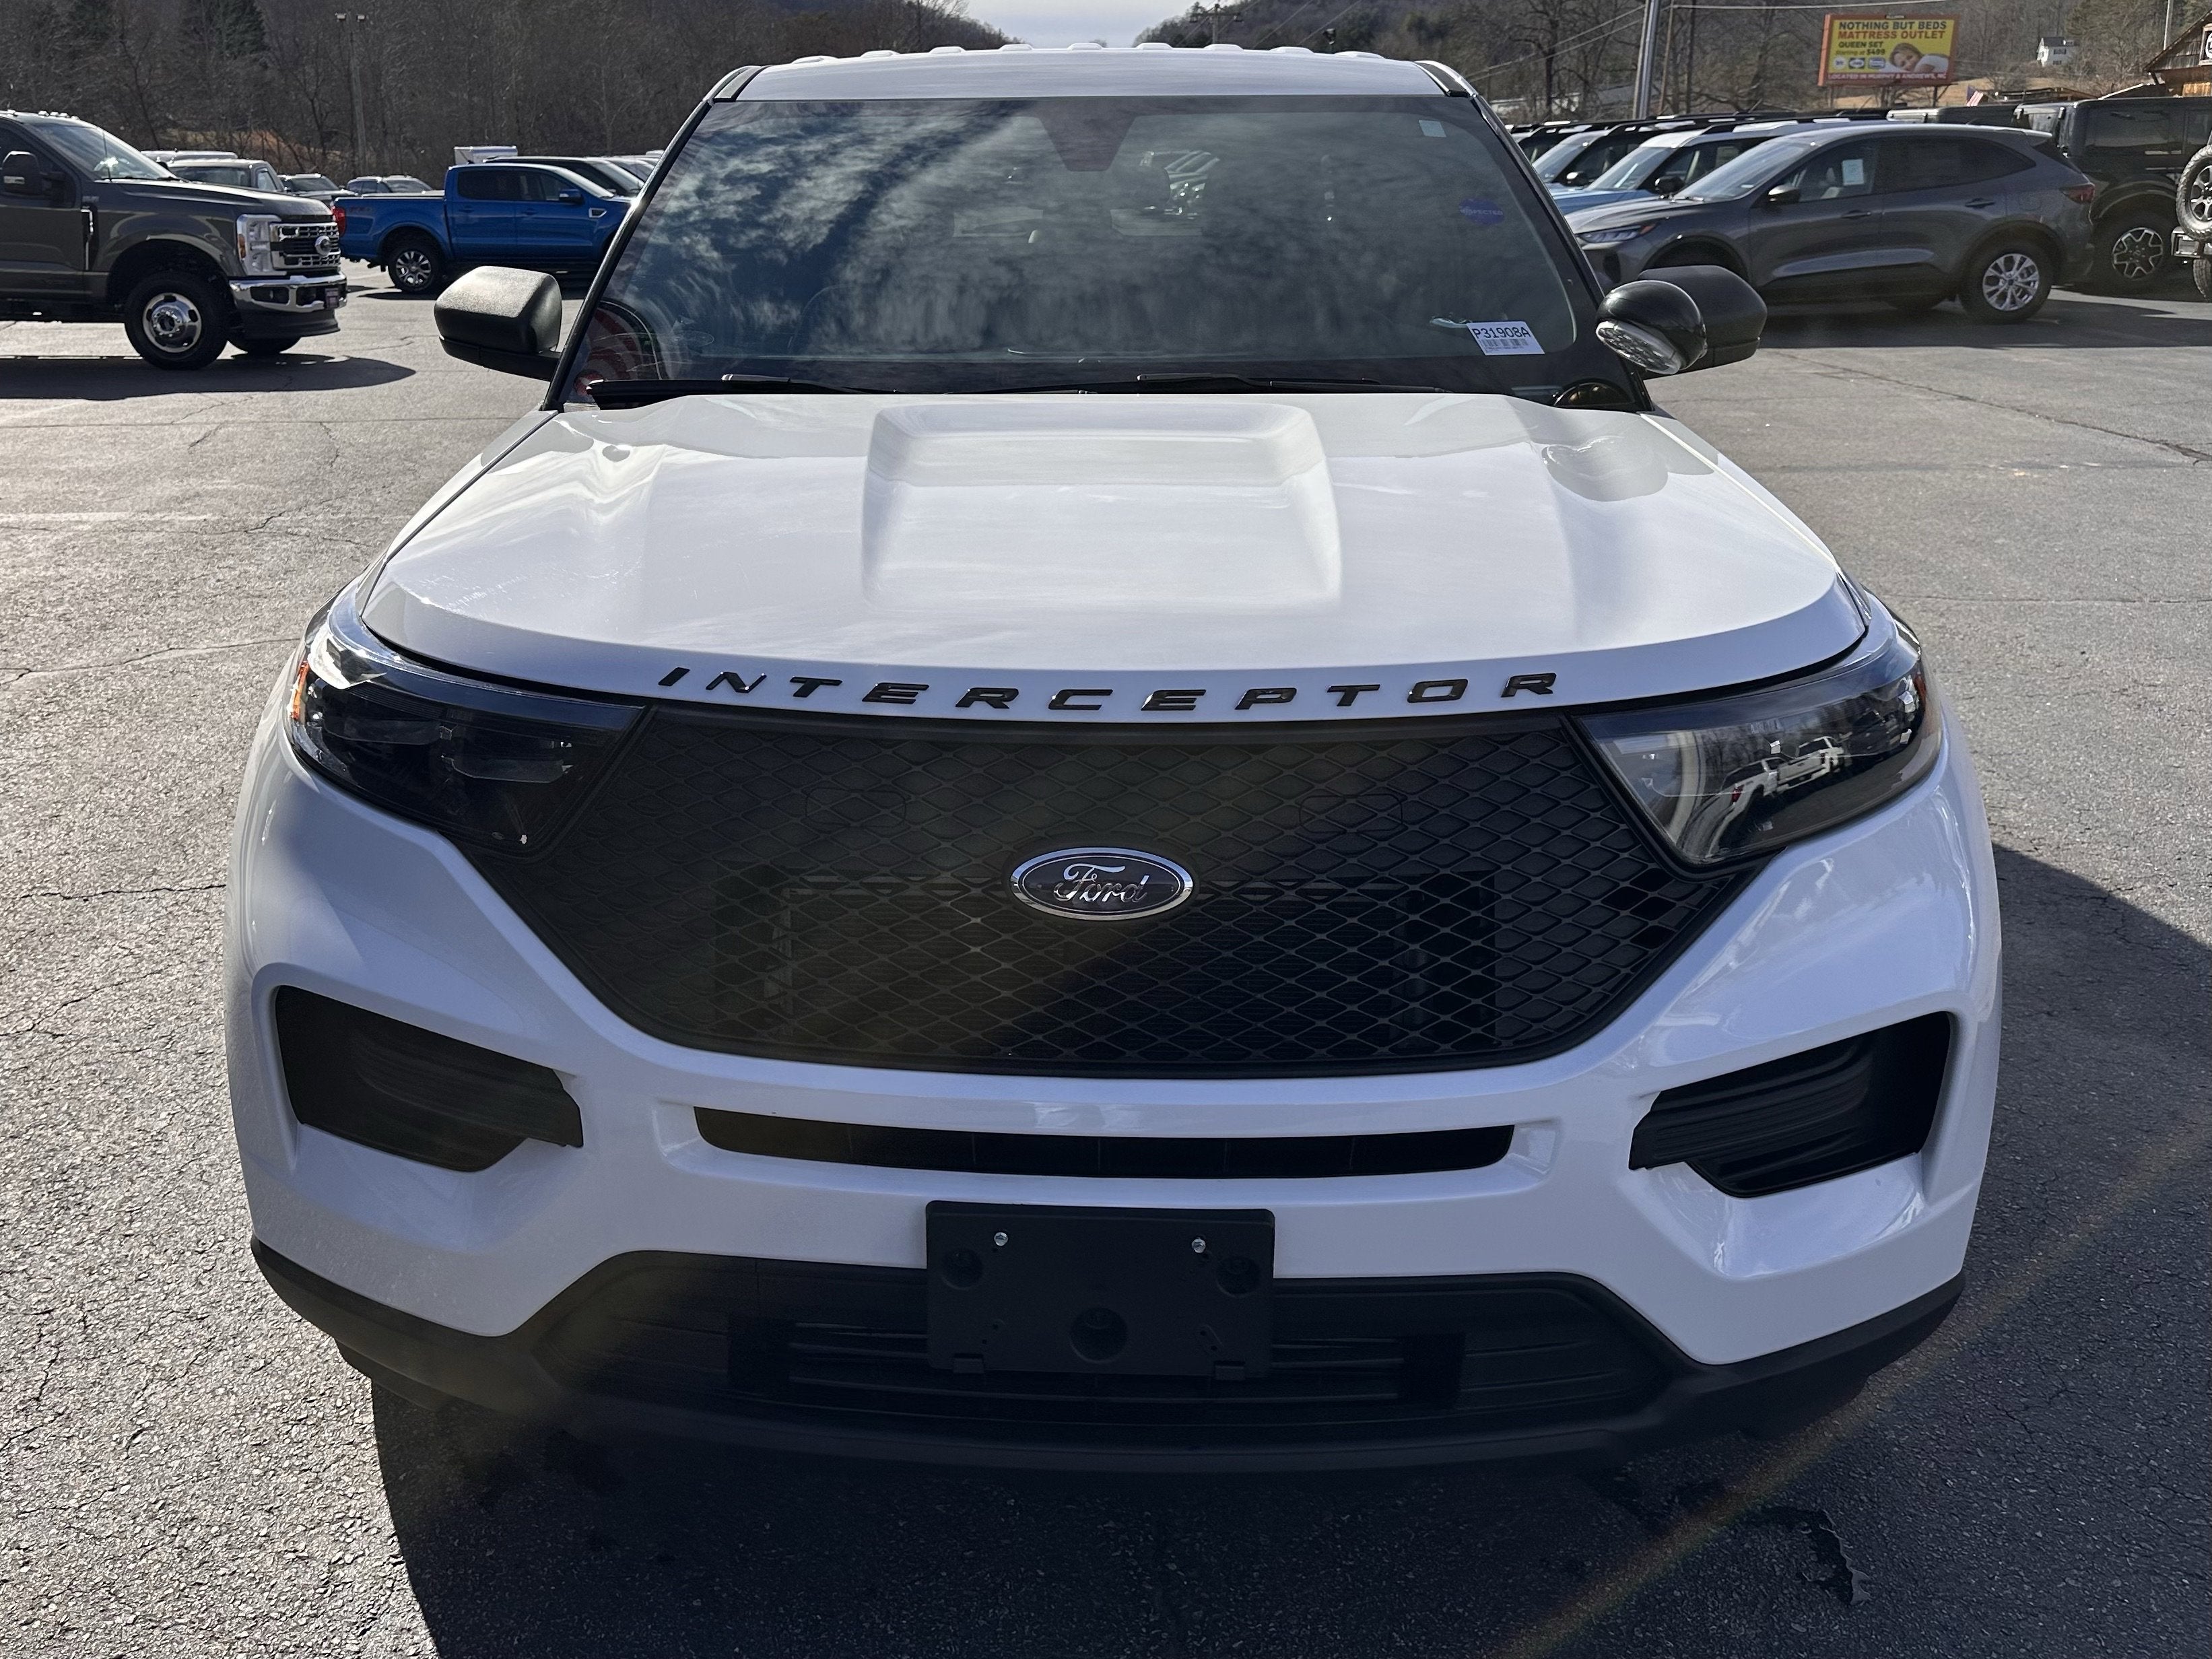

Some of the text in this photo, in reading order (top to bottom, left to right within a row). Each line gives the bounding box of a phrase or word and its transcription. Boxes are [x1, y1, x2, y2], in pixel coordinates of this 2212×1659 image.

[1839, 22, 1947, 30] NOTHING BUT BEDS
[1838, 31, 1945, 39] MATTRESS OUTLET
[1472, 327, 1531, 339] P31908A
[658, 667, 1557, 710] INTERCEPTOR
[1052, 862, 1150, 903] Ford
